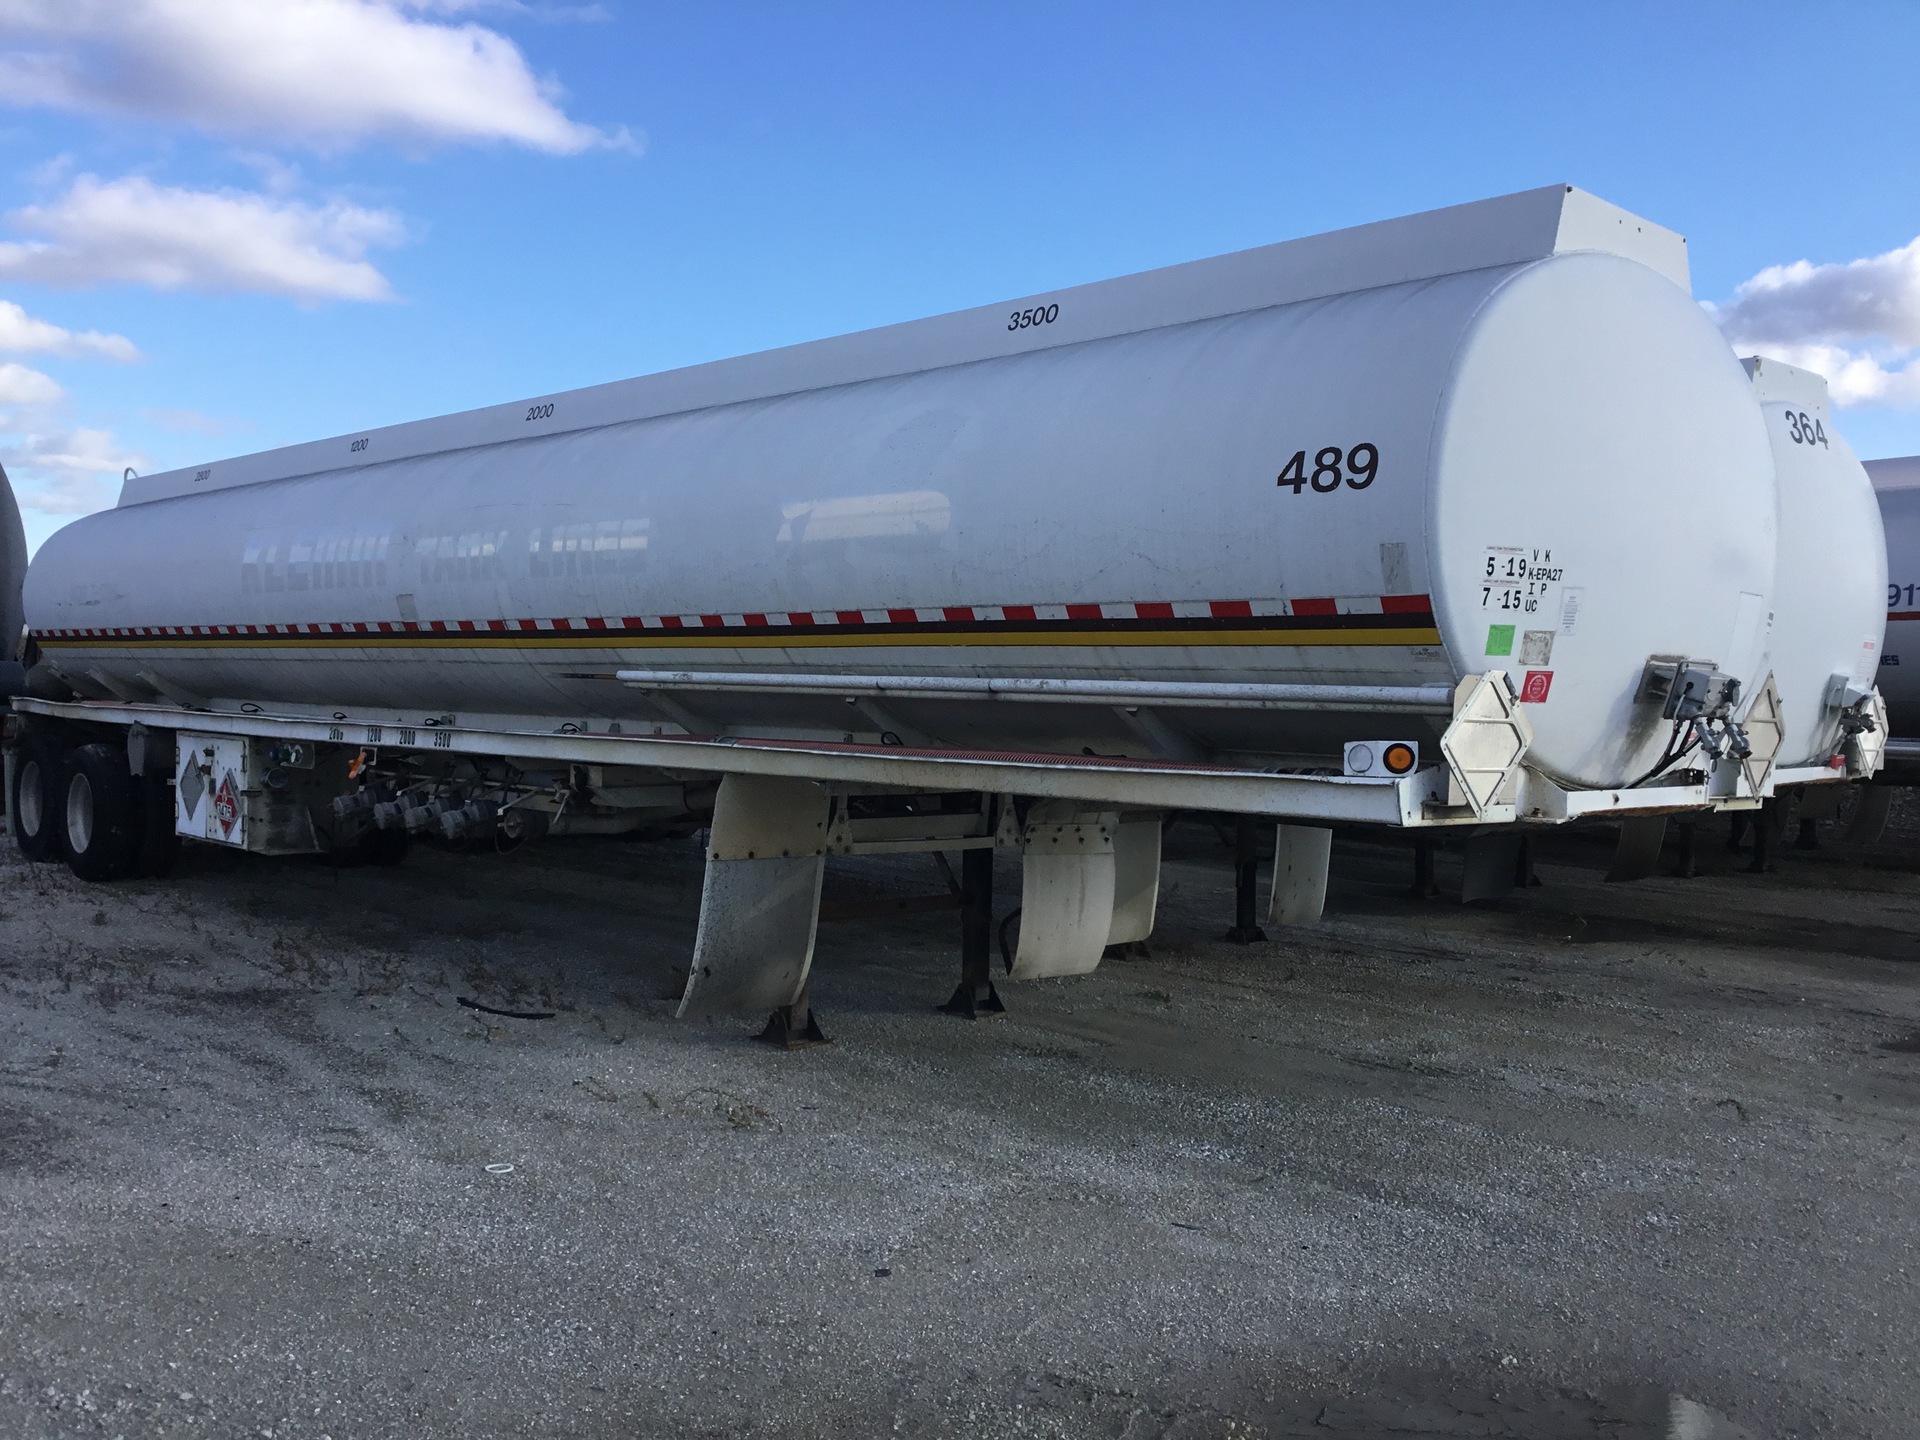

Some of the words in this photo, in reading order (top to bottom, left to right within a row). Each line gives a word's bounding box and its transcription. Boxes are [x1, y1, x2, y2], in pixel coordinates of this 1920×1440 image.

[1008, 304, 1059, 331] 3500
[526, 403, 554, 421] 2000
[1785, 410, 1829, 450] 364
[350, 438, 369, 452] 1200
[1277, 443, 1379, 494] 489
[1528, 567, 1563, 581] K-EPA27
[1525, 599, 1538, 612] UC
[1888, 583, 1920, 607] 91
[367, 727, 382, 742] 1200
[399, 729, 416, 745] 2000
[434, 731, 451, 748] 3500
